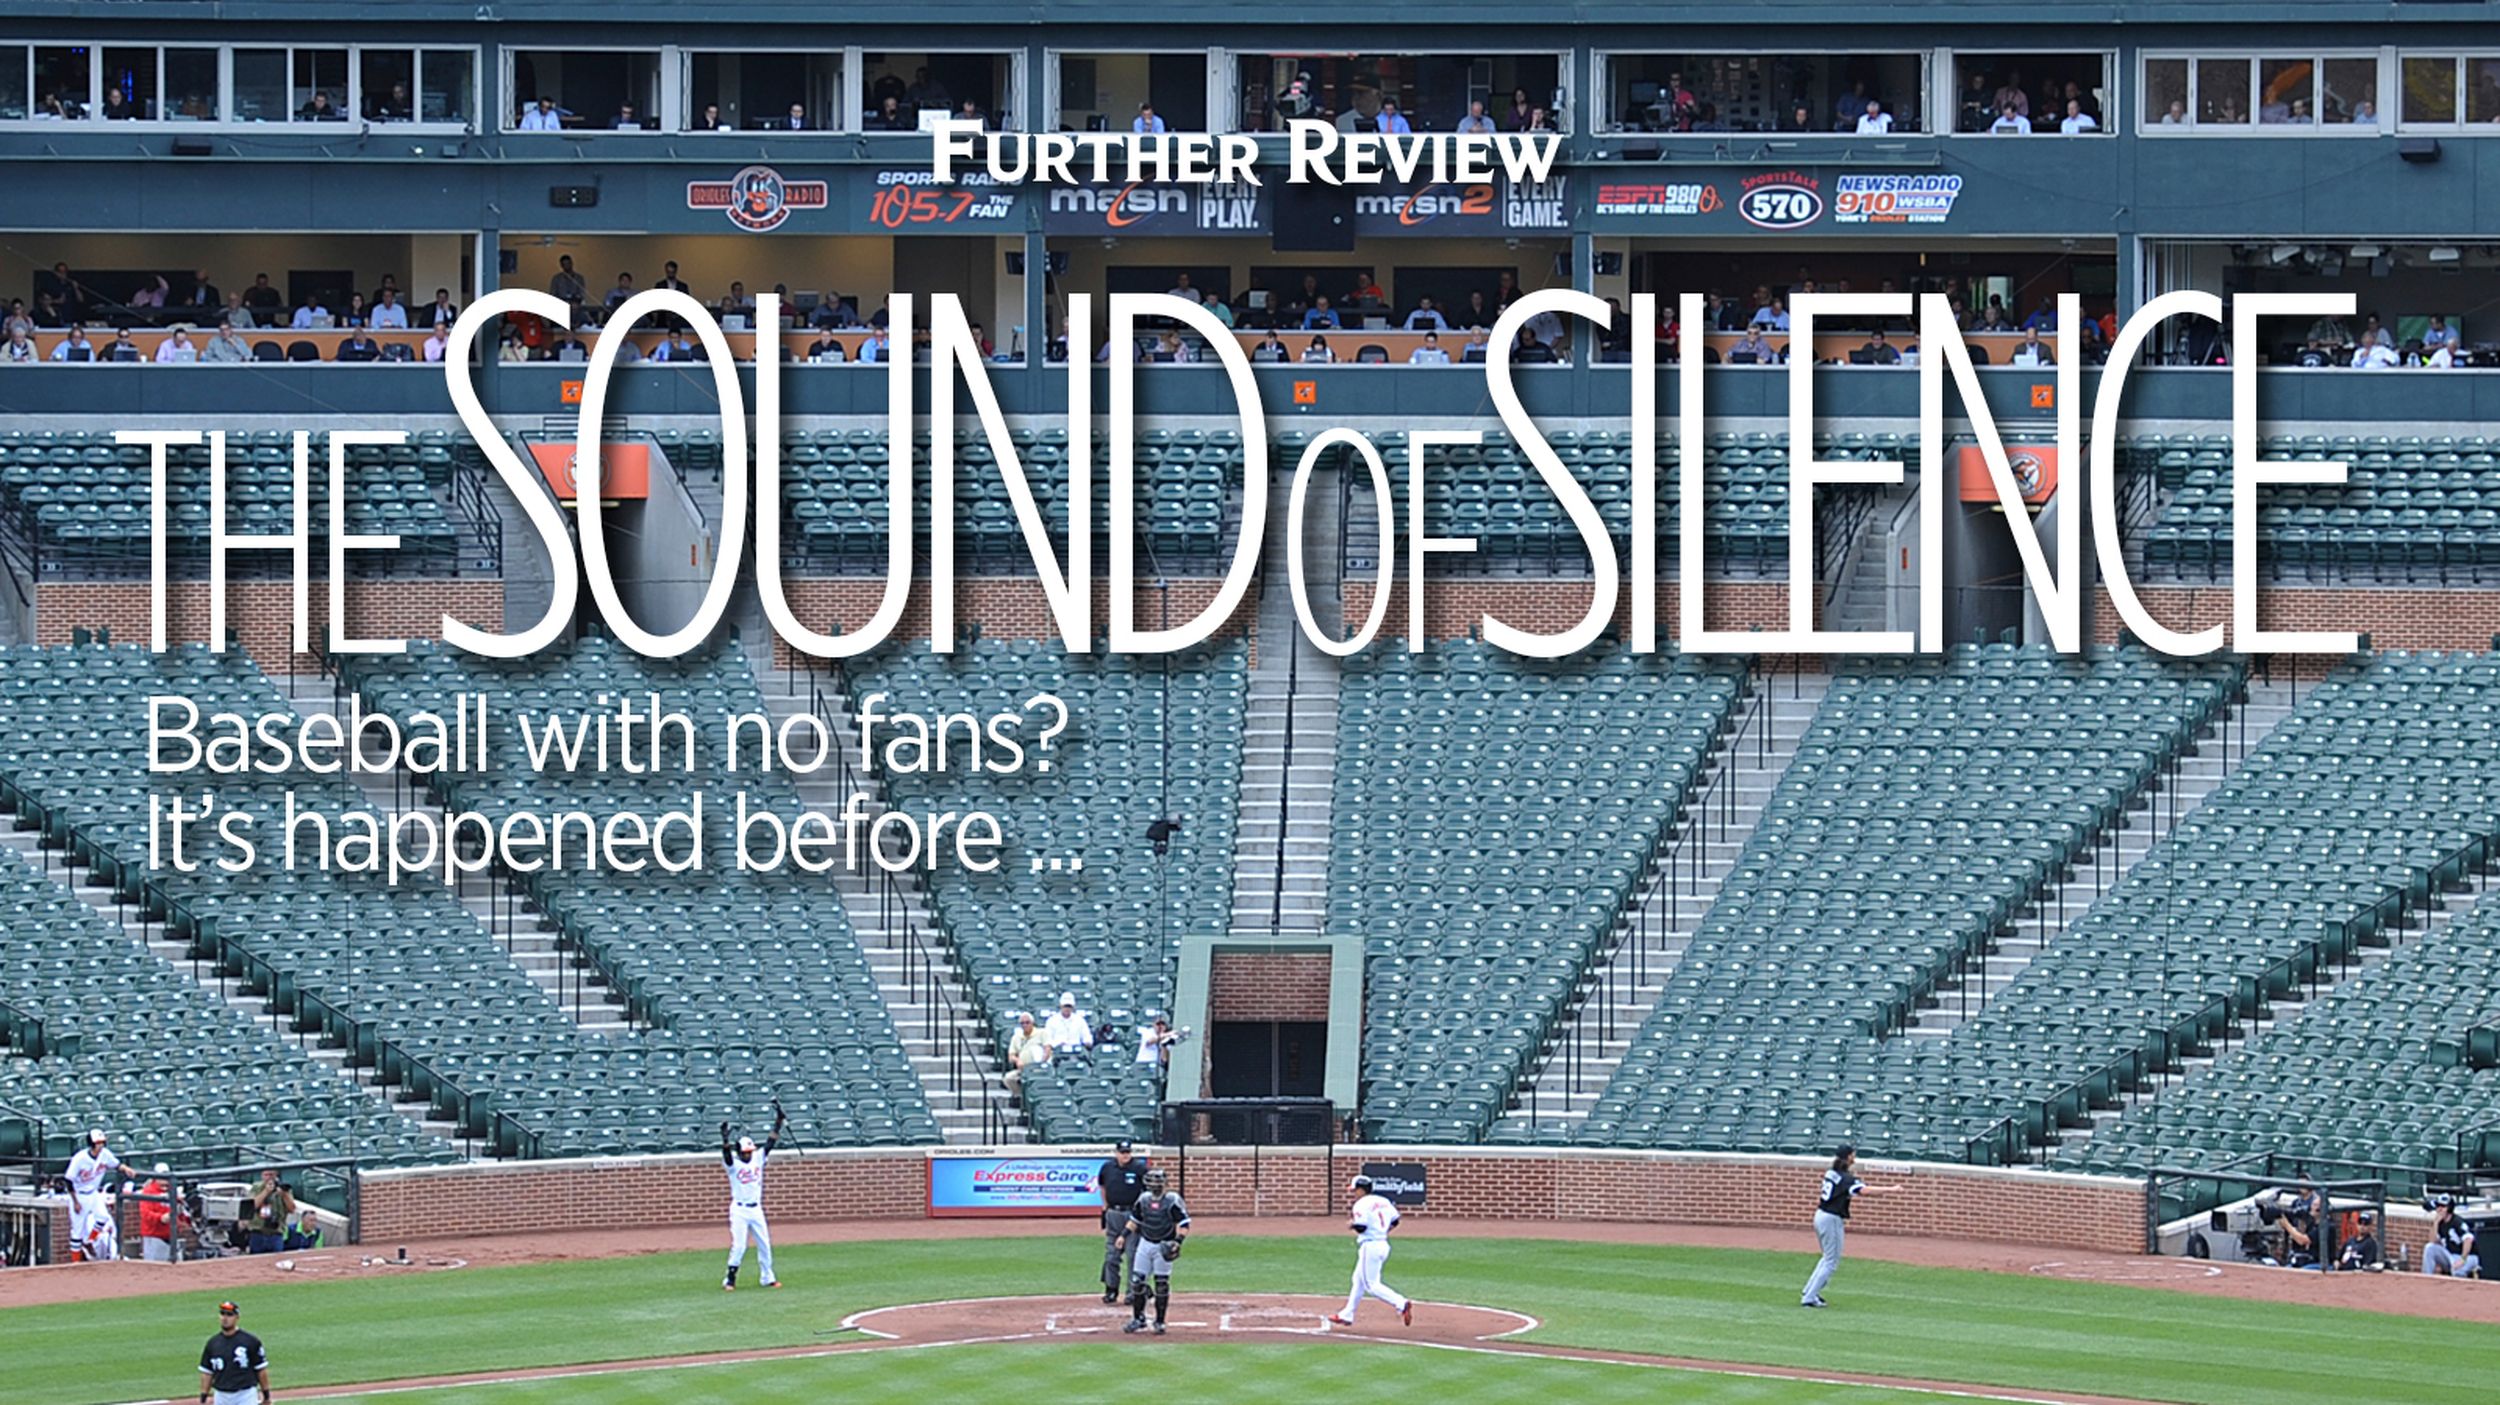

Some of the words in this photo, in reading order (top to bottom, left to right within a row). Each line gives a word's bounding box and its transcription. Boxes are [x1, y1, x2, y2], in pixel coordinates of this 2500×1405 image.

[877, 172, 956, 186] SPOR
[1508, 175, 1566, 200] EVERY
[1838, 177, 1960, 191] NEWSRADIO
[785, 187, 822, 203] RADIO
[990, 195, 1013, 204] THE
[1050, 186, 1187, 215] masn
[1356, 185, 1494, 215] masn2
[1598, 185, 1665, 204] ESPN
[1665, 185, 1702, 204] 980
[1838, 192, 1895, 213] 910
[969, 204, 1008, 217] FAN
[1203, 199, 1258, 228] PLAY.
[1508, 201, 1568, 227] GAME.
[1752, 193, 1811, 220] 570
[974, 1170, 1089, 1183] ExpressCare
